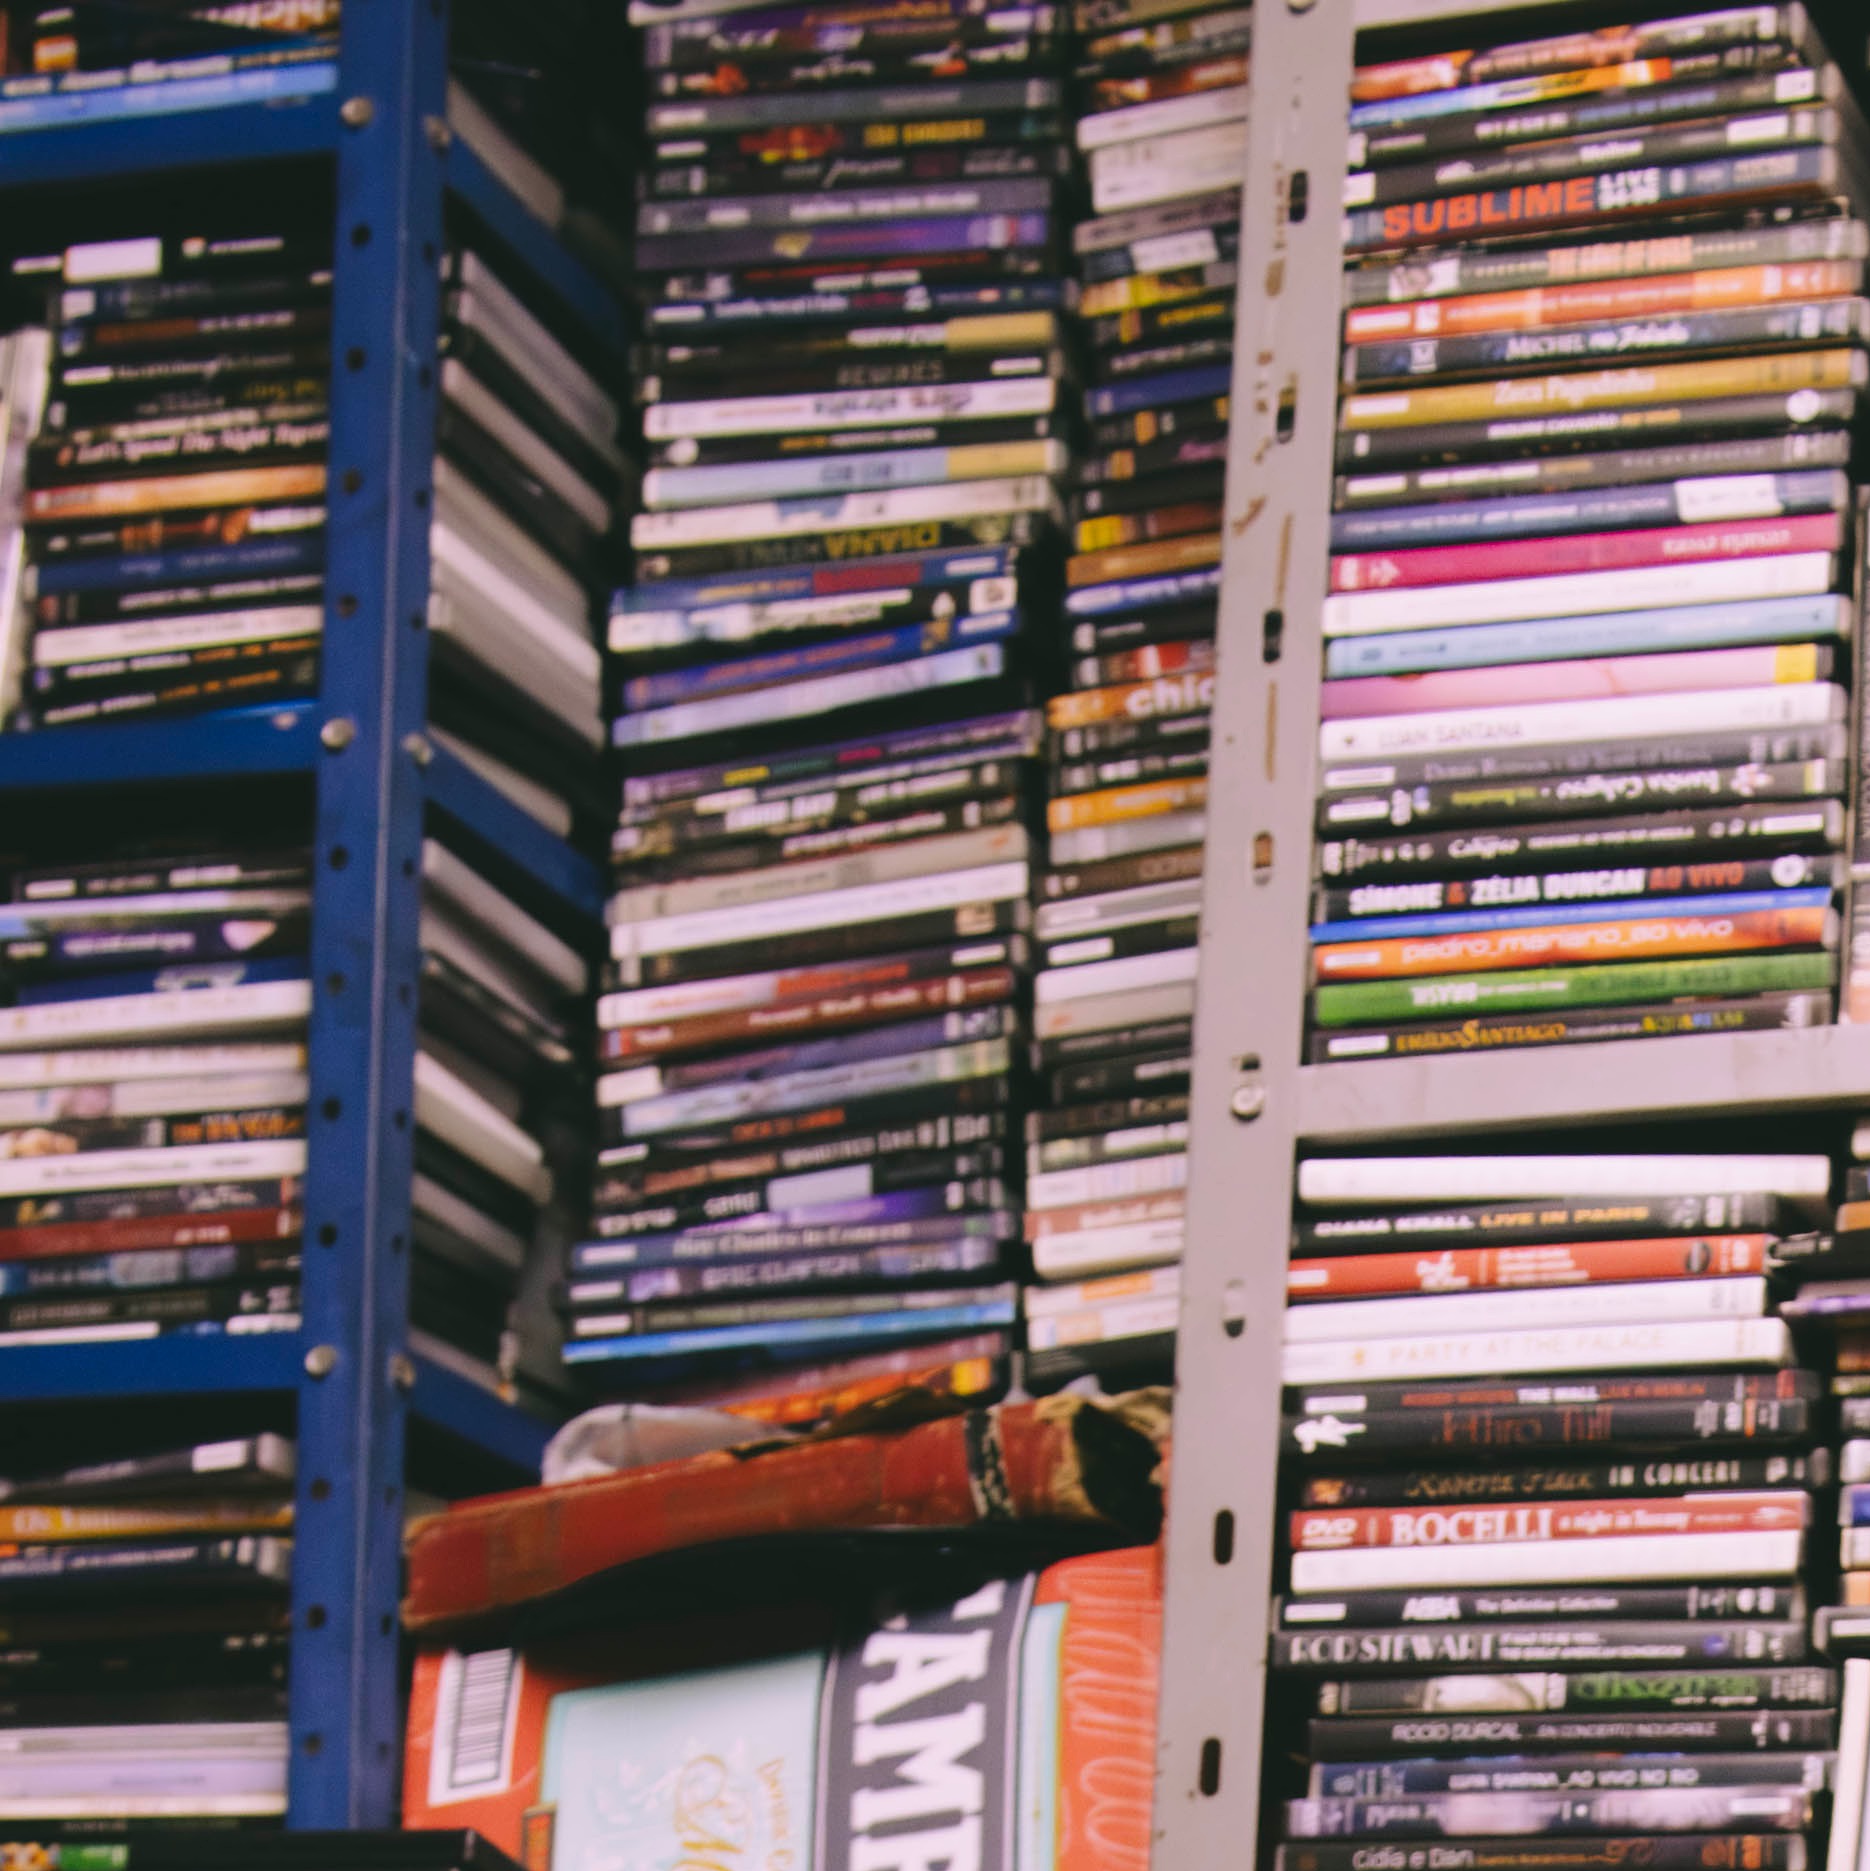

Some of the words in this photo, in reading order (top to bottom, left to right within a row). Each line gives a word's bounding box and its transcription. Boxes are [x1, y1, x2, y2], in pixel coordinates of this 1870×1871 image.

[1383, 178, 1595, 239] SUBLIME
[1391, 1510, 1553, 1545] BOCELLI
[1353, 1632, 1497, 1660] STEWART
